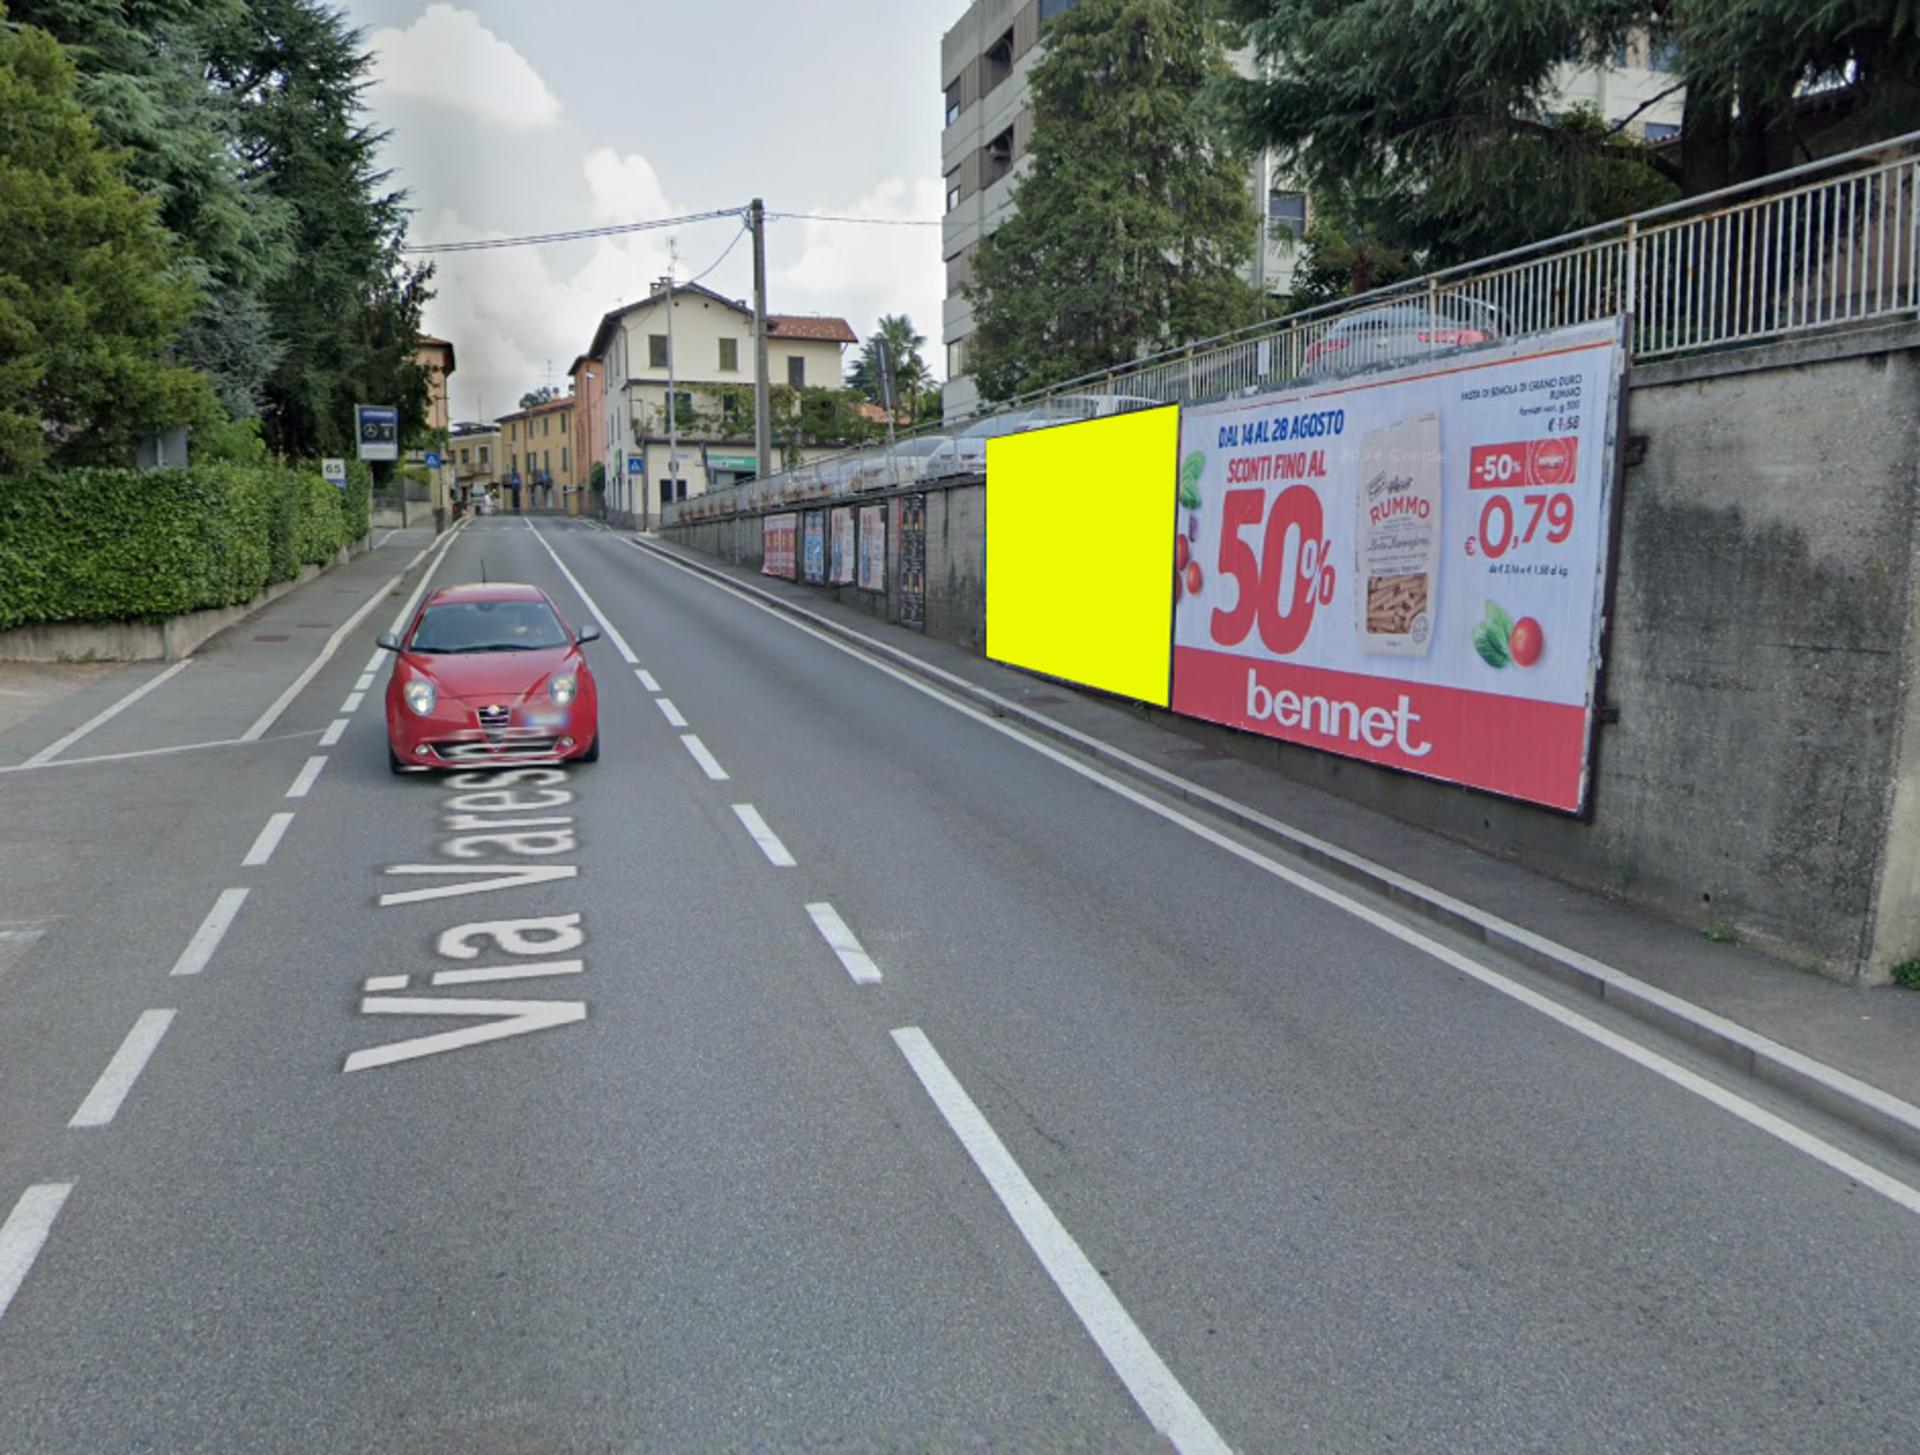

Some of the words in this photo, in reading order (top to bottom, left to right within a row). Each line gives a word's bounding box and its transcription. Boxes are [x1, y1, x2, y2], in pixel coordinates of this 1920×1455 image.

[1528, 377, 1557, 391] GRANO
[1558, 374, 1582, 388] DURO
[1218, 425, 1239, 449] DAL
[1241, 423, 1255, 445] 14
[1254, 420, 1270, 444] AL
[1271, 416, 1289, 442] 28
[1289, 409, 1345, 440] AGOSTO
[325, 465, 342, 475] 65
[1227, 455, 1272, 483] SCONTI
[1273, 451, 1307, 480] FINO
[1307, 450, 1326, 478] AL
[1475, 453, 1521, 482] -50%
[1370, 495, 1431, 526] RUMMO
[1479, 492, 1575, 559] 0,79
[1209, 484, 1336, 655] 50%
[1247, 668, 1432, 756] bennet
